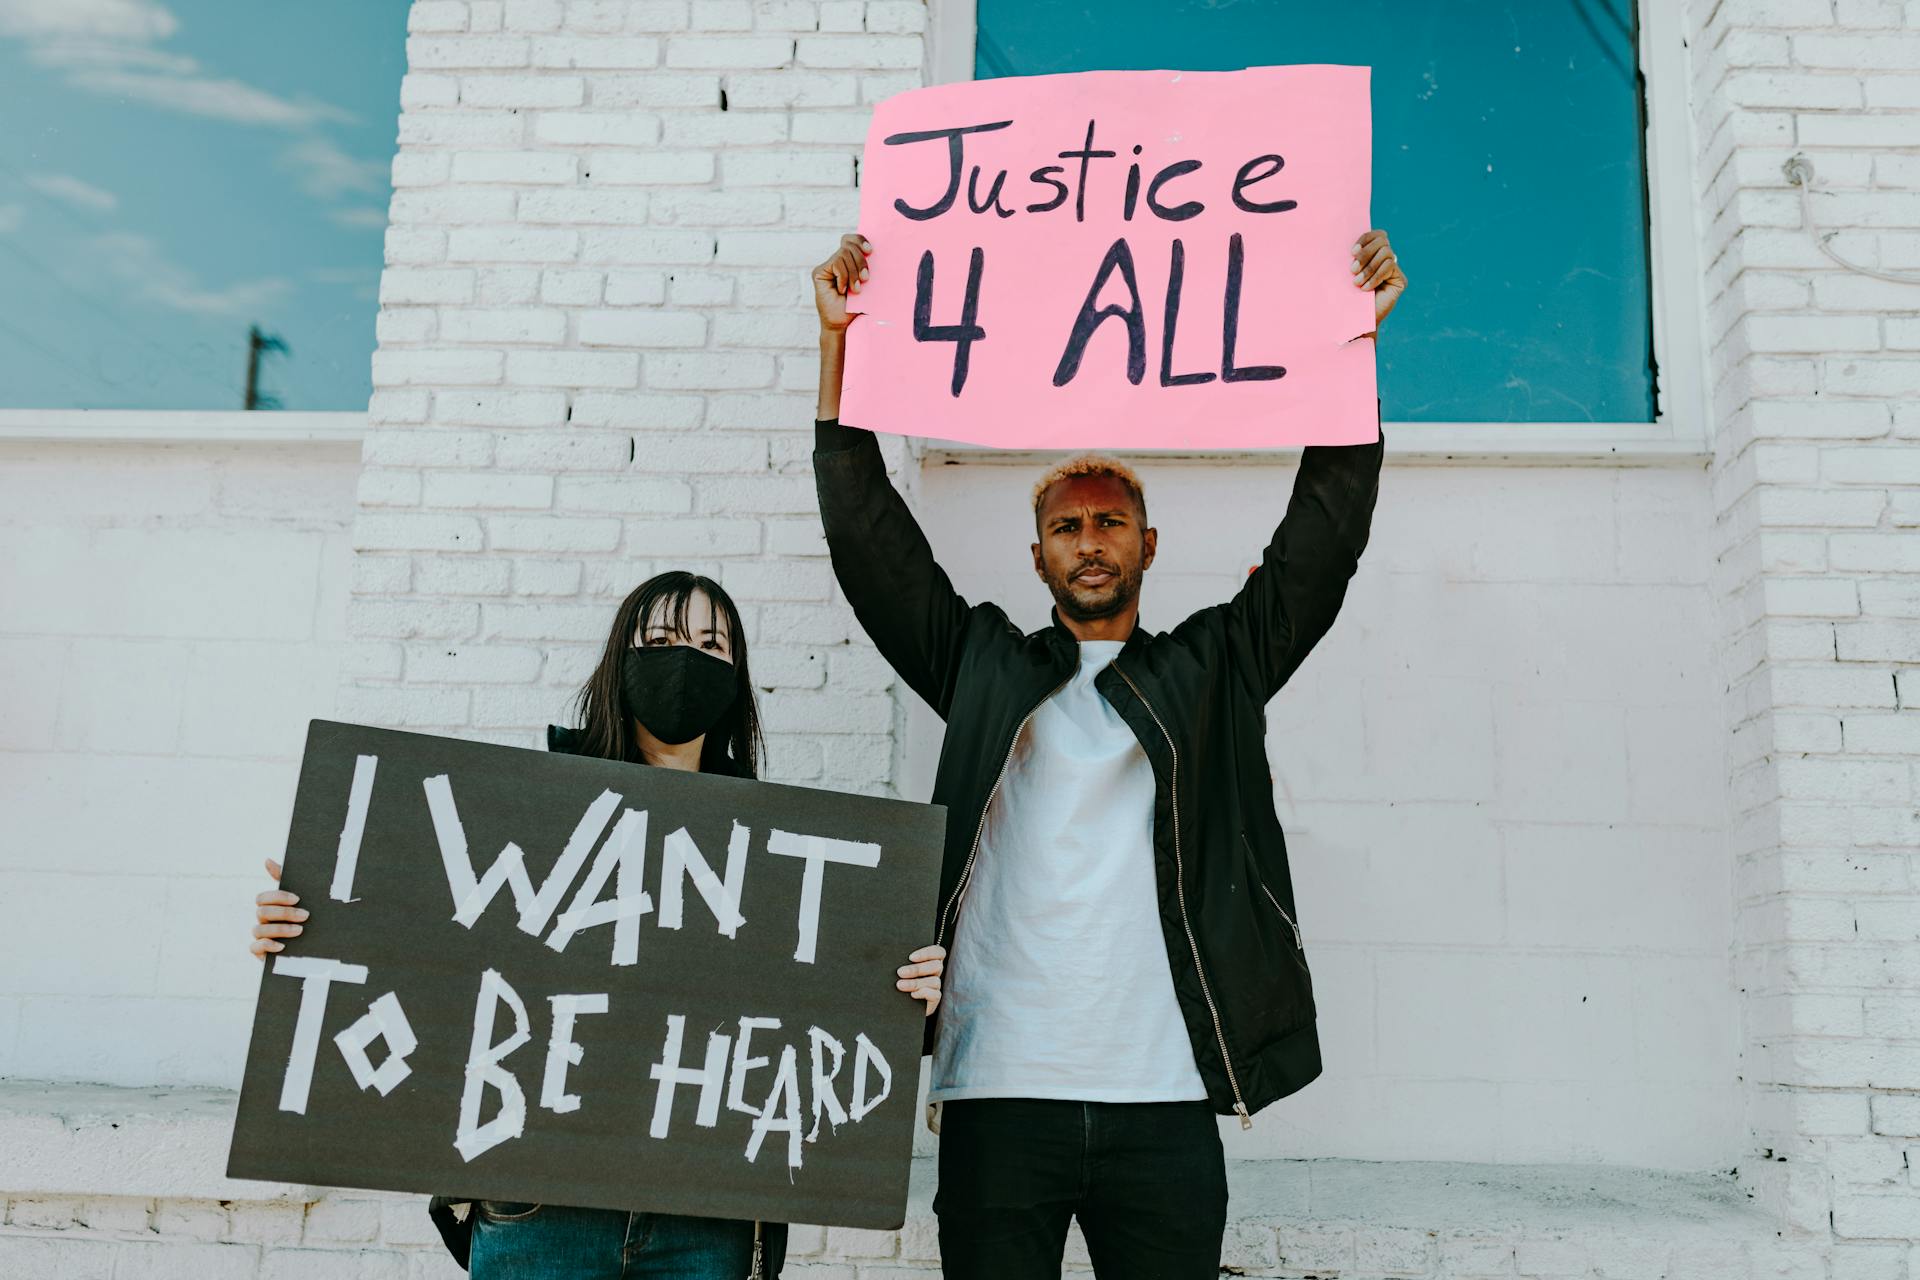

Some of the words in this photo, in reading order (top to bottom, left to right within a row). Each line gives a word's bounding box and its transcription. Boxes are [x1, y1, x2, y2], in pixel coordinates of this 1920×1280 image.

[884, 119, 1297, 222] Justice
[913, 247, 986, 397] 4
[1053, 233, 1286, 387] ALL
[330, 755, 378, 903] I
[423, 774, 882, 966] WANT
[272, 956, 418, 1115] TO
[453, 968, 609, 1163] BE
[650, 1015, 891, 1176] HEARD
